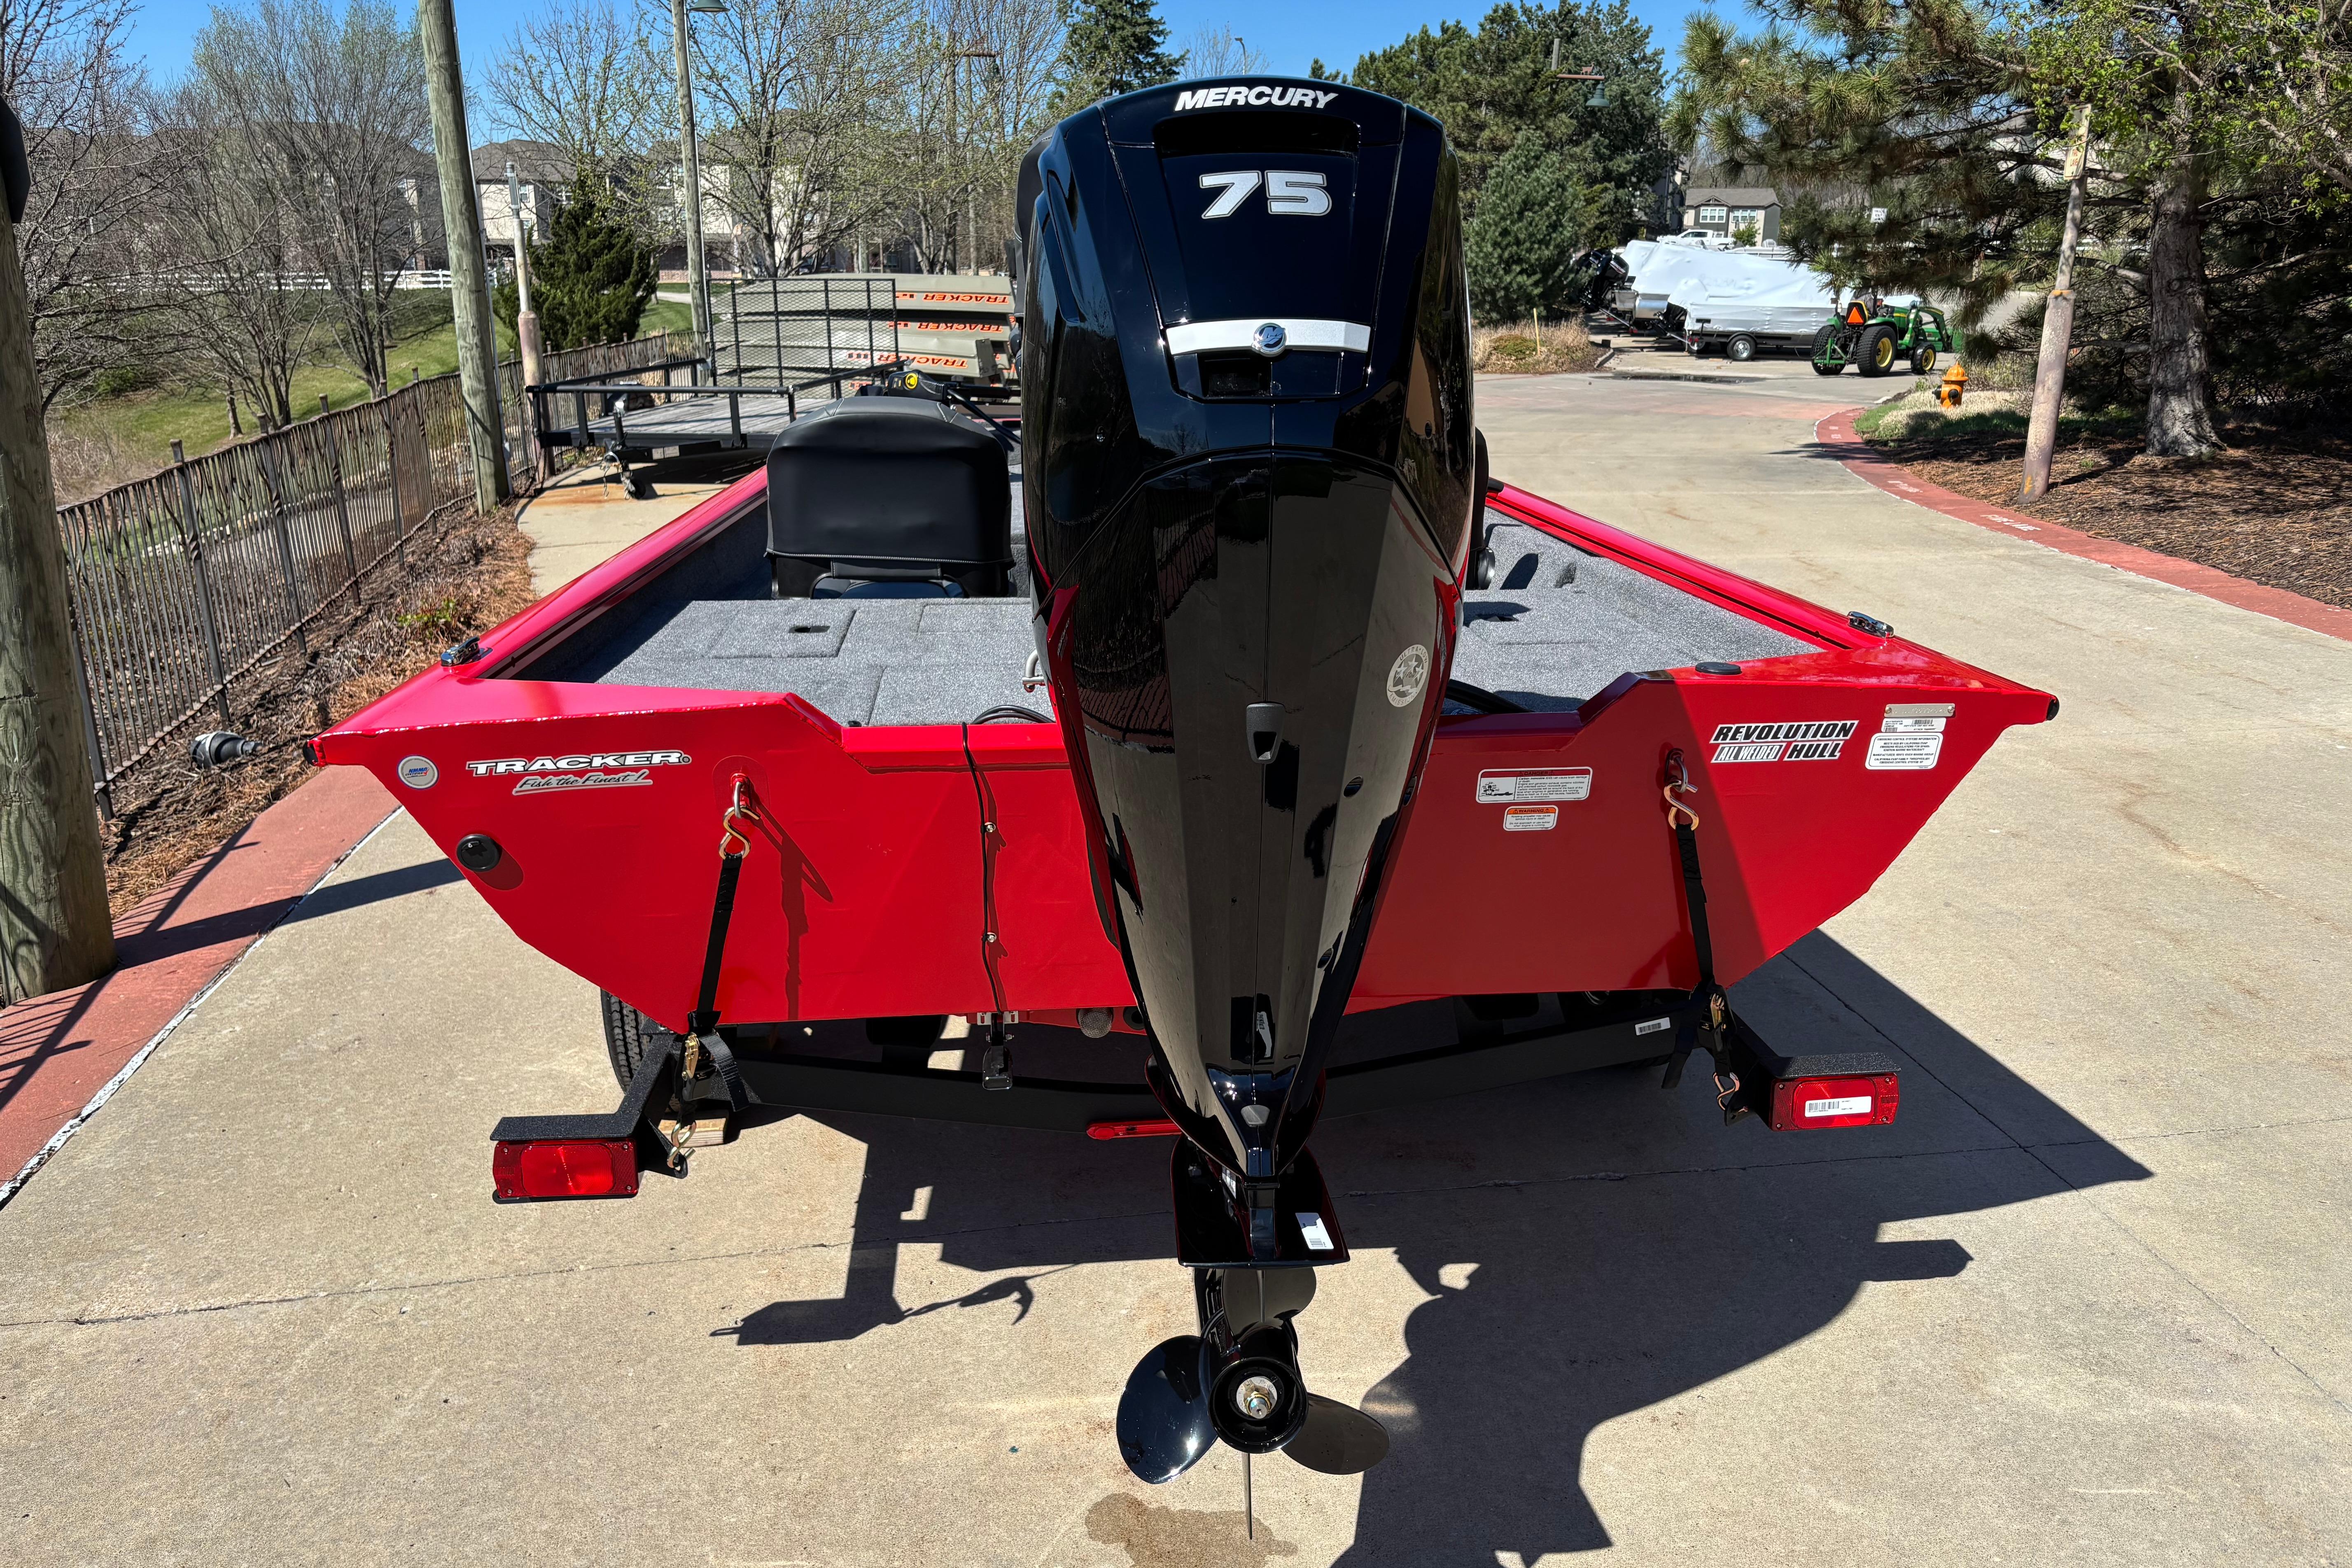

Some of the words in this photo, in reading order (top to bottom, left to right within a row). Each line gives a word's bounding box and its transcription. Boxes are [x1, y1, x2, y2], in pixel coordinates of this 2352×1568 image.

[1174, 86, 1339, 111] MERCURY
[1199, 170, 1332, 219] 75
[924, 293, 1009, 303] TRACKER
[917, 322, 1003, 332] TRACKER
[1713, 722, 1856, 741] REVOLUTION
[1717, 746, 1739, 761] ALL
[1738, 745, 1780, 760] WELDED
[1786, 742, 1842, 759] HULL
[519, 778, 553, 789] Fish
[555, 777, 580, 786] the
